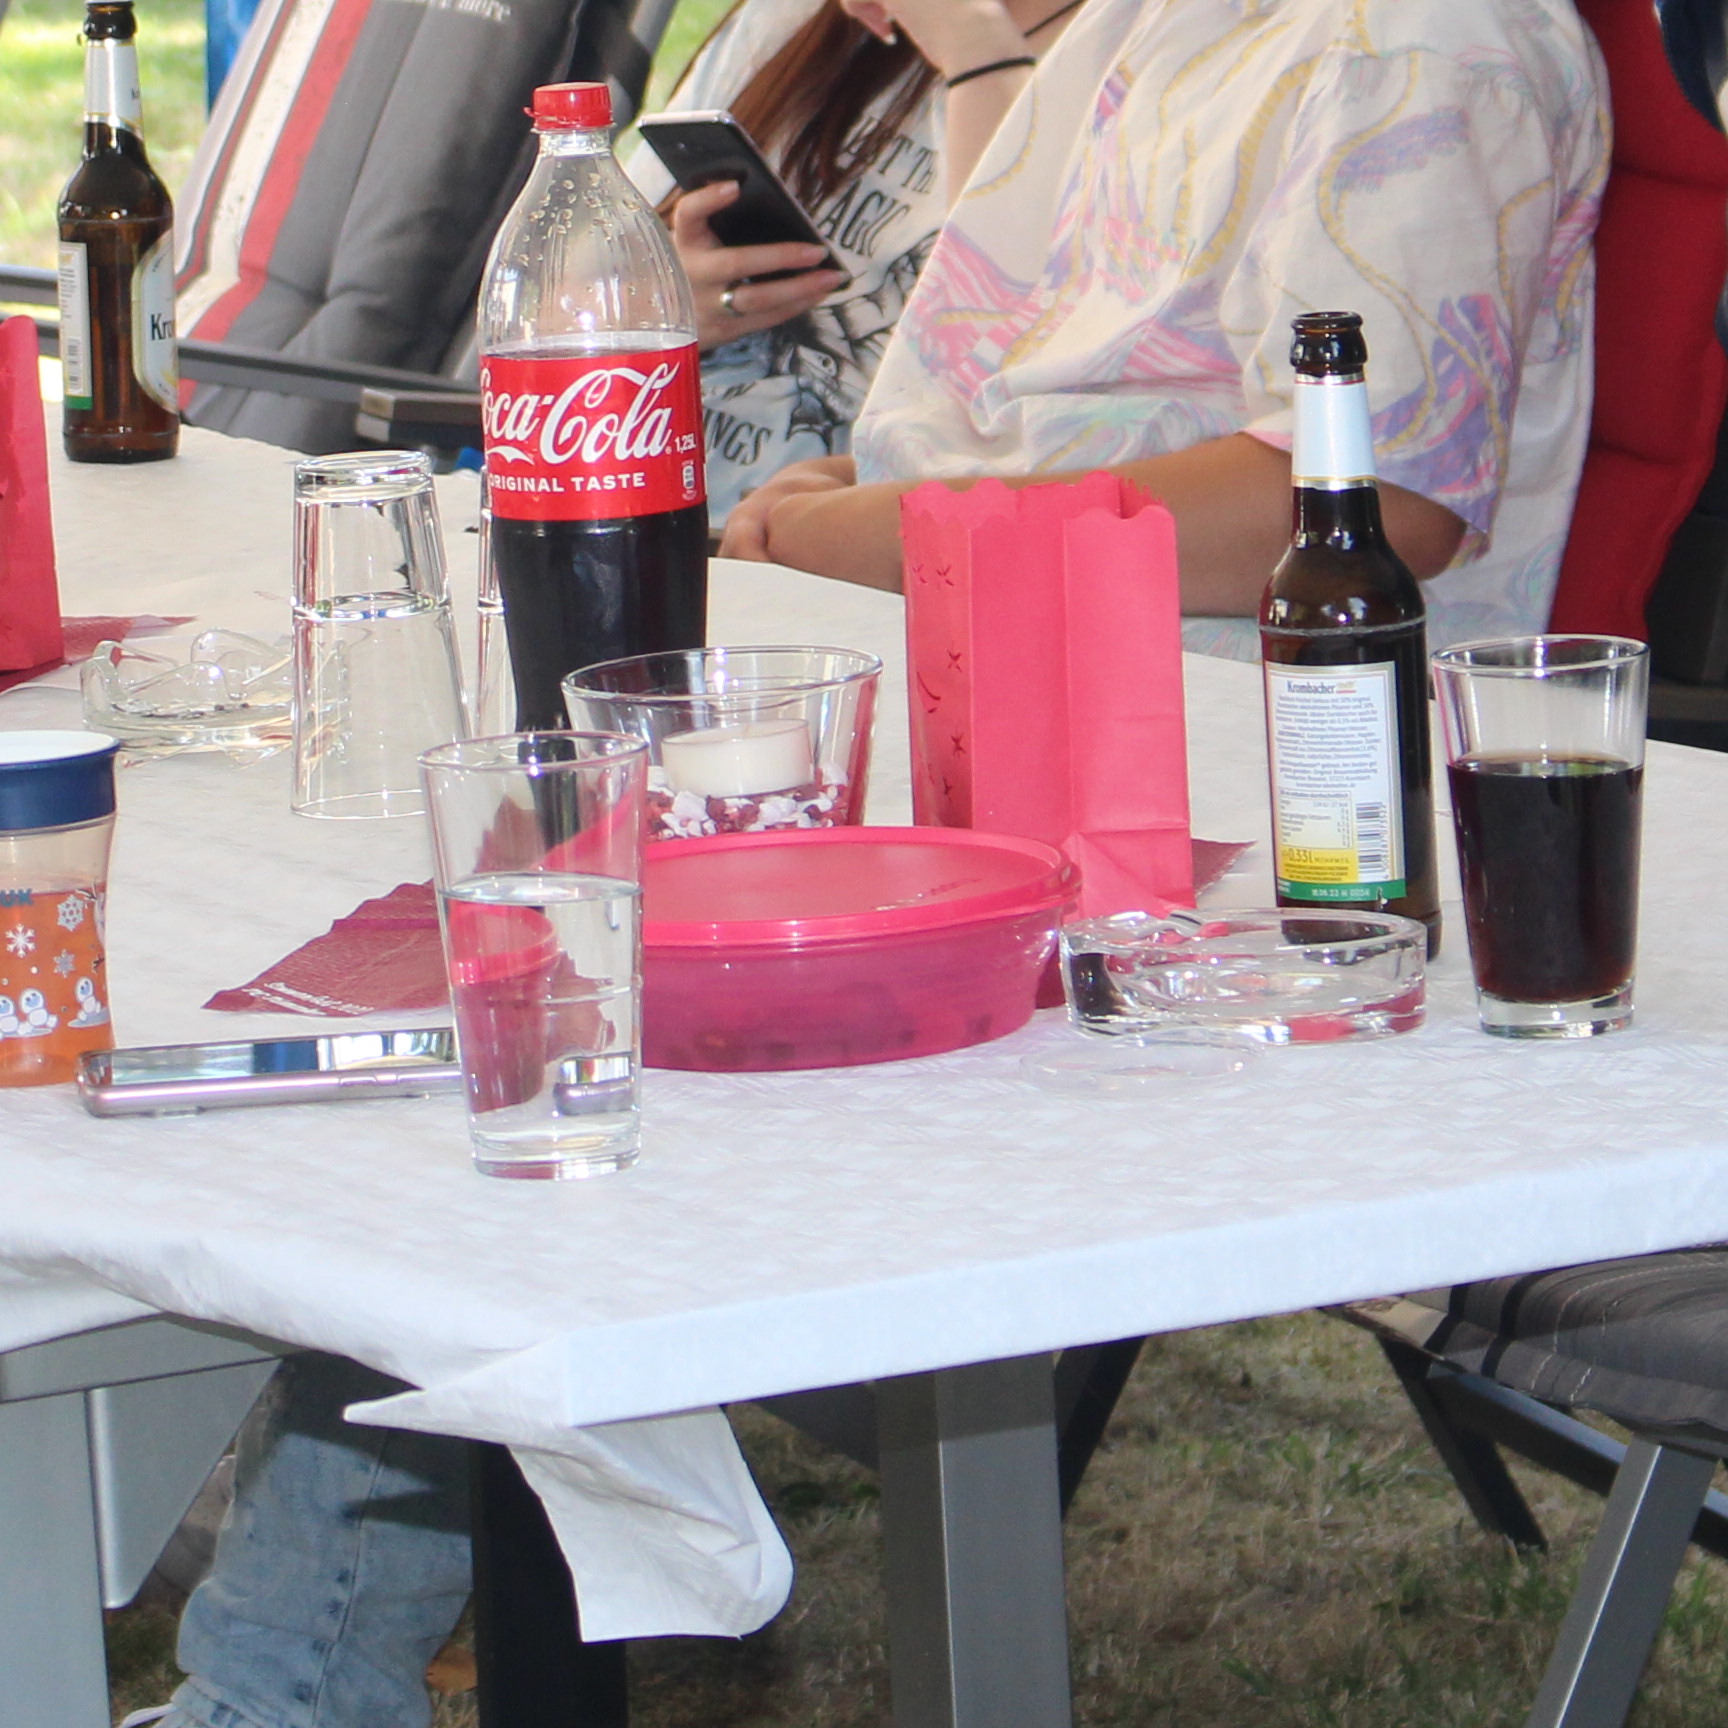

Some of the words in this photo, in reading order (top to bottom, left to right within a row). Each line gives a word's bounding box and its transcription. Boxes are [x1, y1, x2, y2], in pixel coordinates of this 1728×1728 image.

[809, 176, 913, 259] AGIC
[570, 471, 646, 492] TASTE
[1287, 680, 1336, 694] Krombacher
